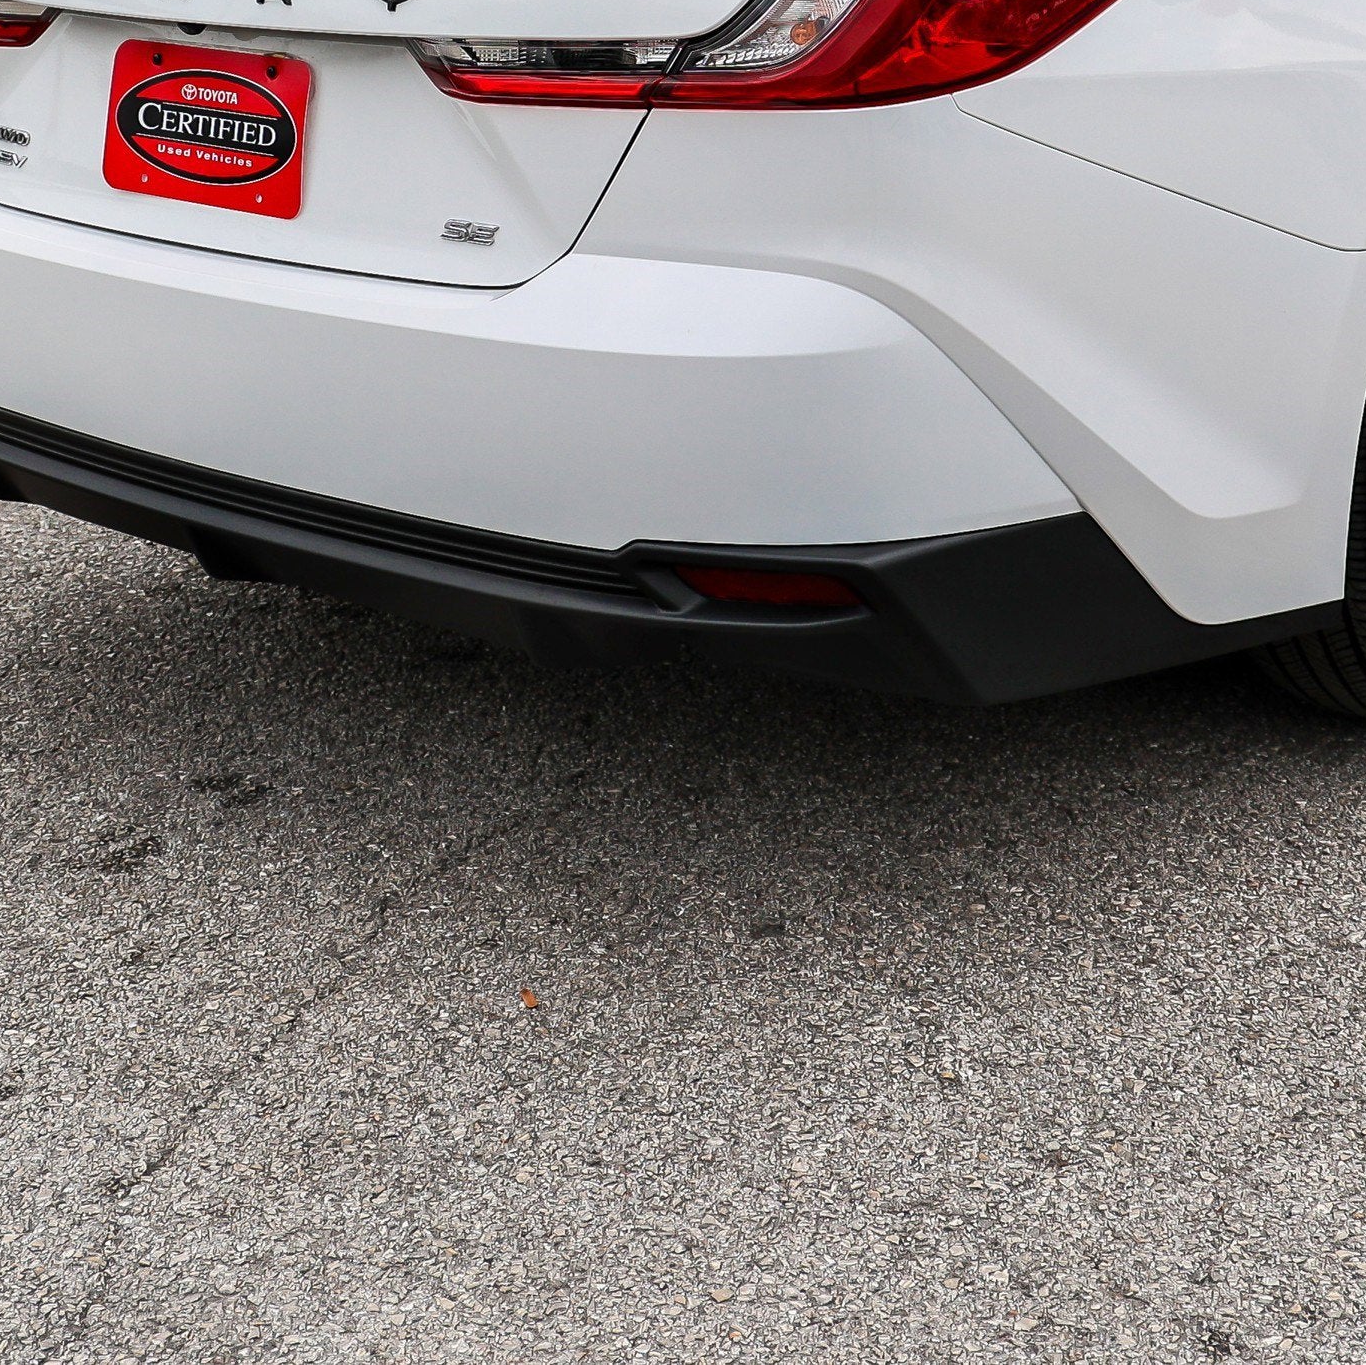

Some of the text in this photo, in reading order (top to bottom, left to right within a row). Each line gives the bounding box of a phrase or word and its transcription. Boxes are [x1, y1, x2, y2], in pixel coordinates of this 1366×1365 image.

[198, 86, 238, 105] TOYOTA
[137, 101, 277, 147] CERTIFIED
[157, 143, 253, 168] Used Vehicles
[439, 217, 500, 247] SE
